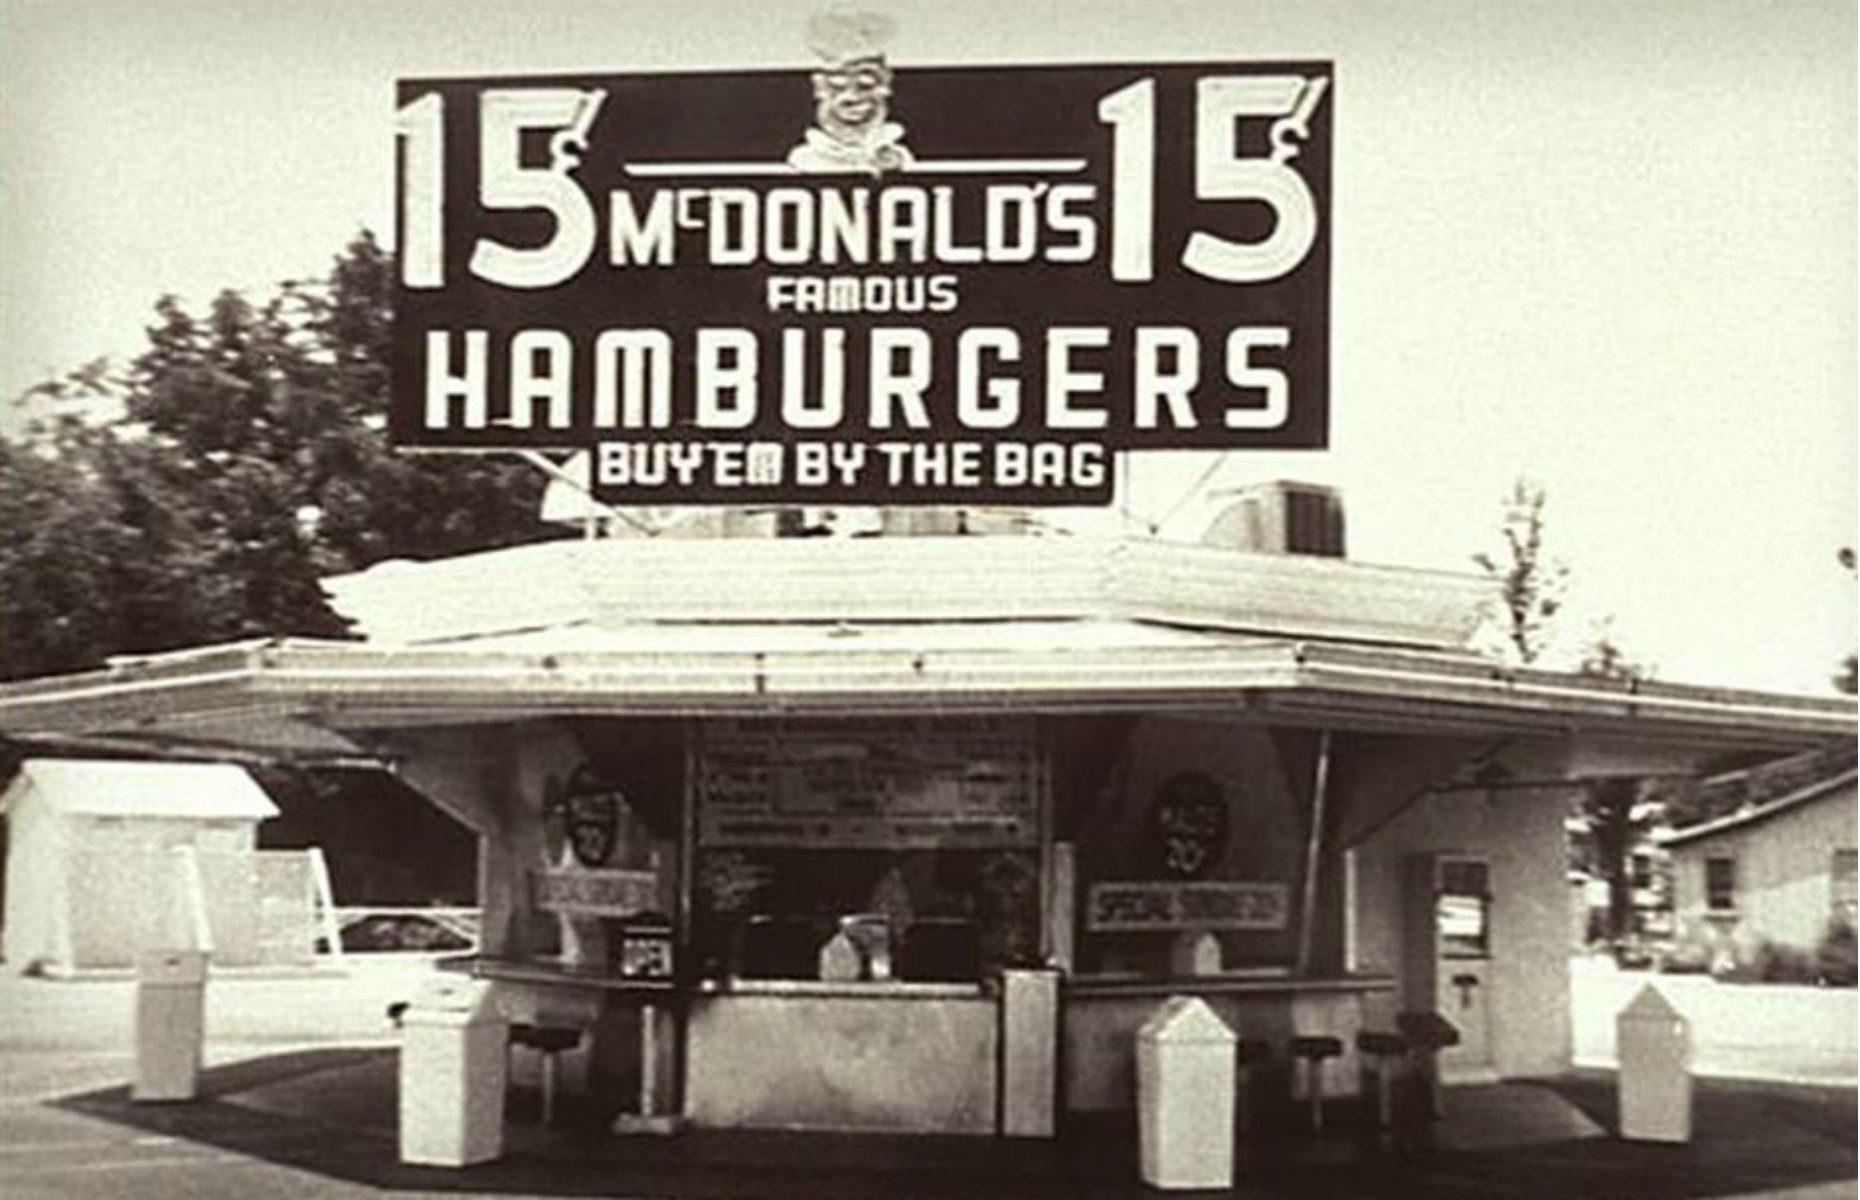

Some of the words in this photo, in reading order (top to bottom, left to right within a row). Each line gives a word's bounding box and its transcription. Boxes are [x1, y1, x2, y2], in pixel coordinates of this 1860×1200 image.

[767, 275, 959, 313] FAMOUS
[424, 327, 1291, 429] HAMBURGERS
[796, 442, 865, 486] BY
[875, 442, 982, 486] THE
[994, 443, 1105, 486] BAG
